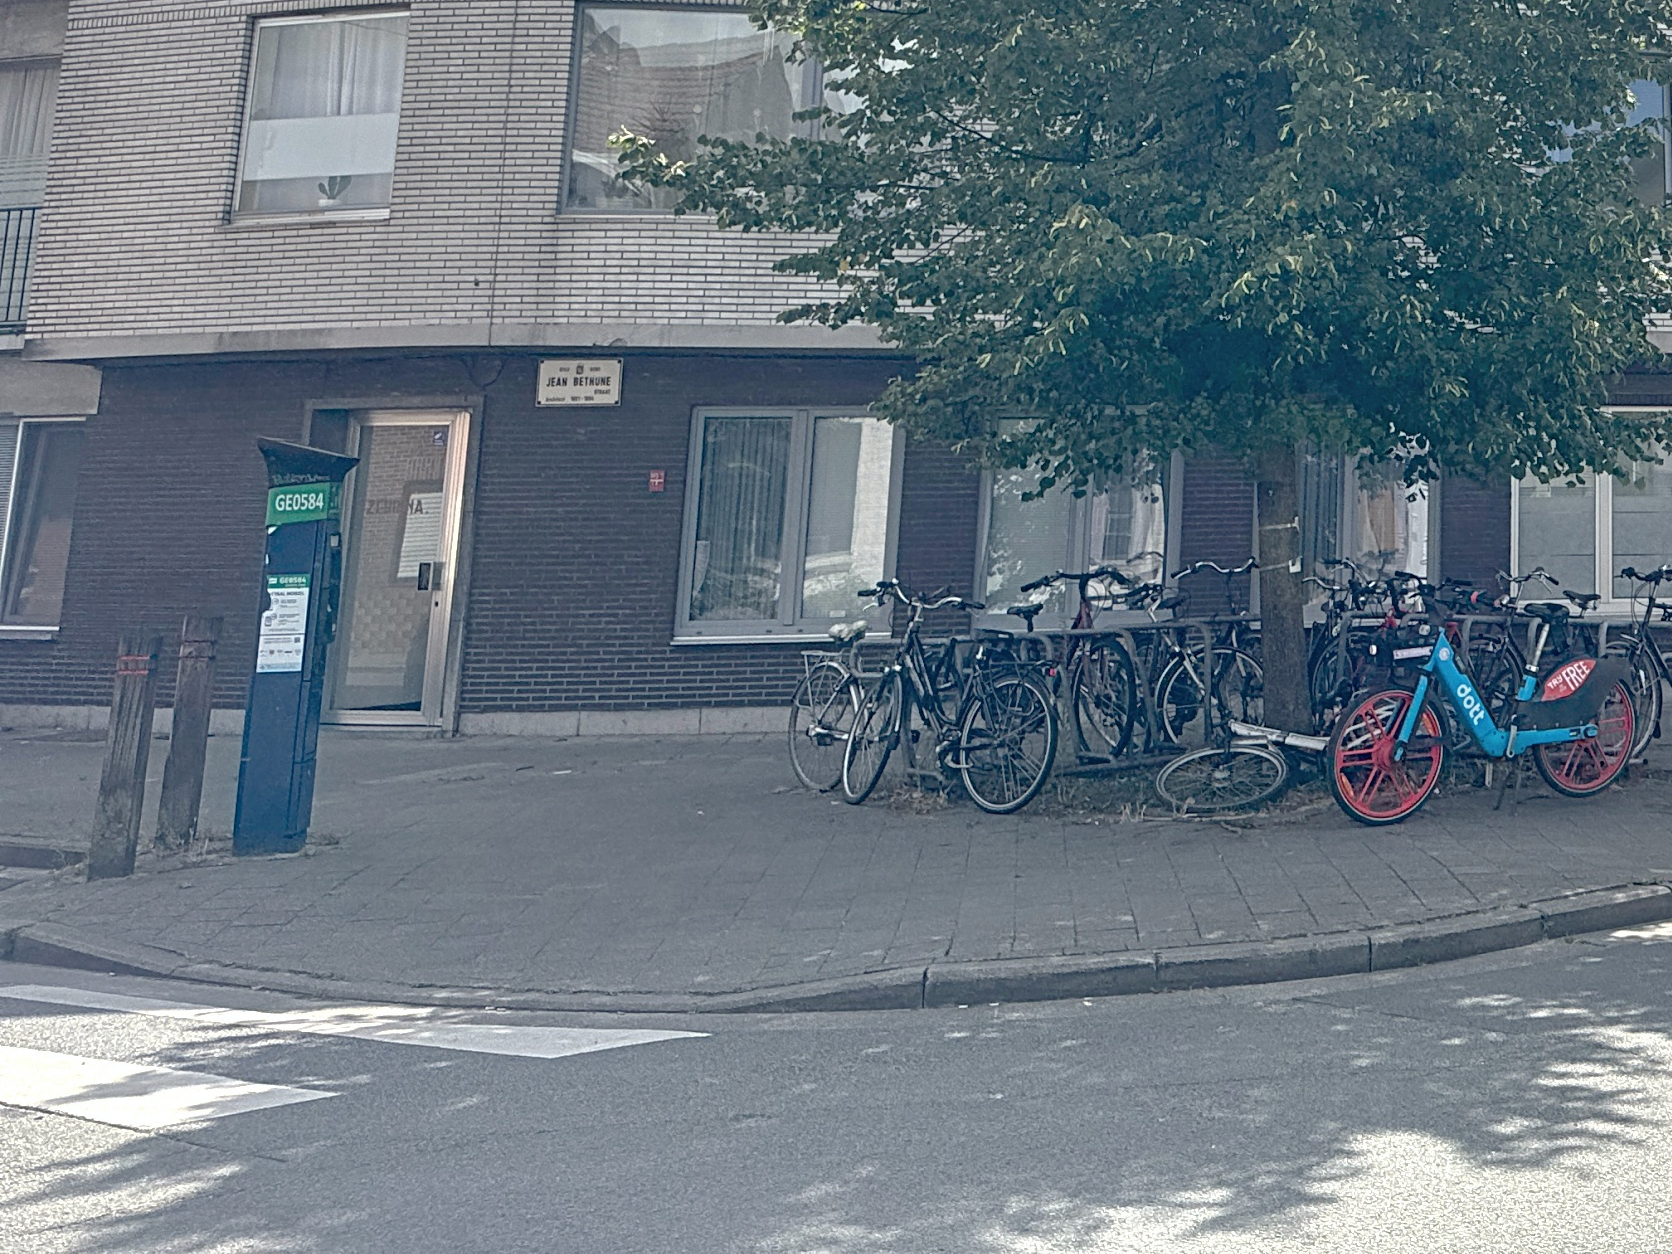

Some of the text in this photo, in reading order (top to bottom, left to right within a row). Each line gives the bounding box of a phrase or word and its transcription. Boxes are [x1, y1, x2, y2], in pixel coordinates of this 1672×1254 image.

[546, 376, 611, 387] JEAN BETHUNE
[275, 492, 325, 512] GE0584
[1547, 661, 1591, 691] TRY FREE
[1456, 683, 1486, 726] dott
